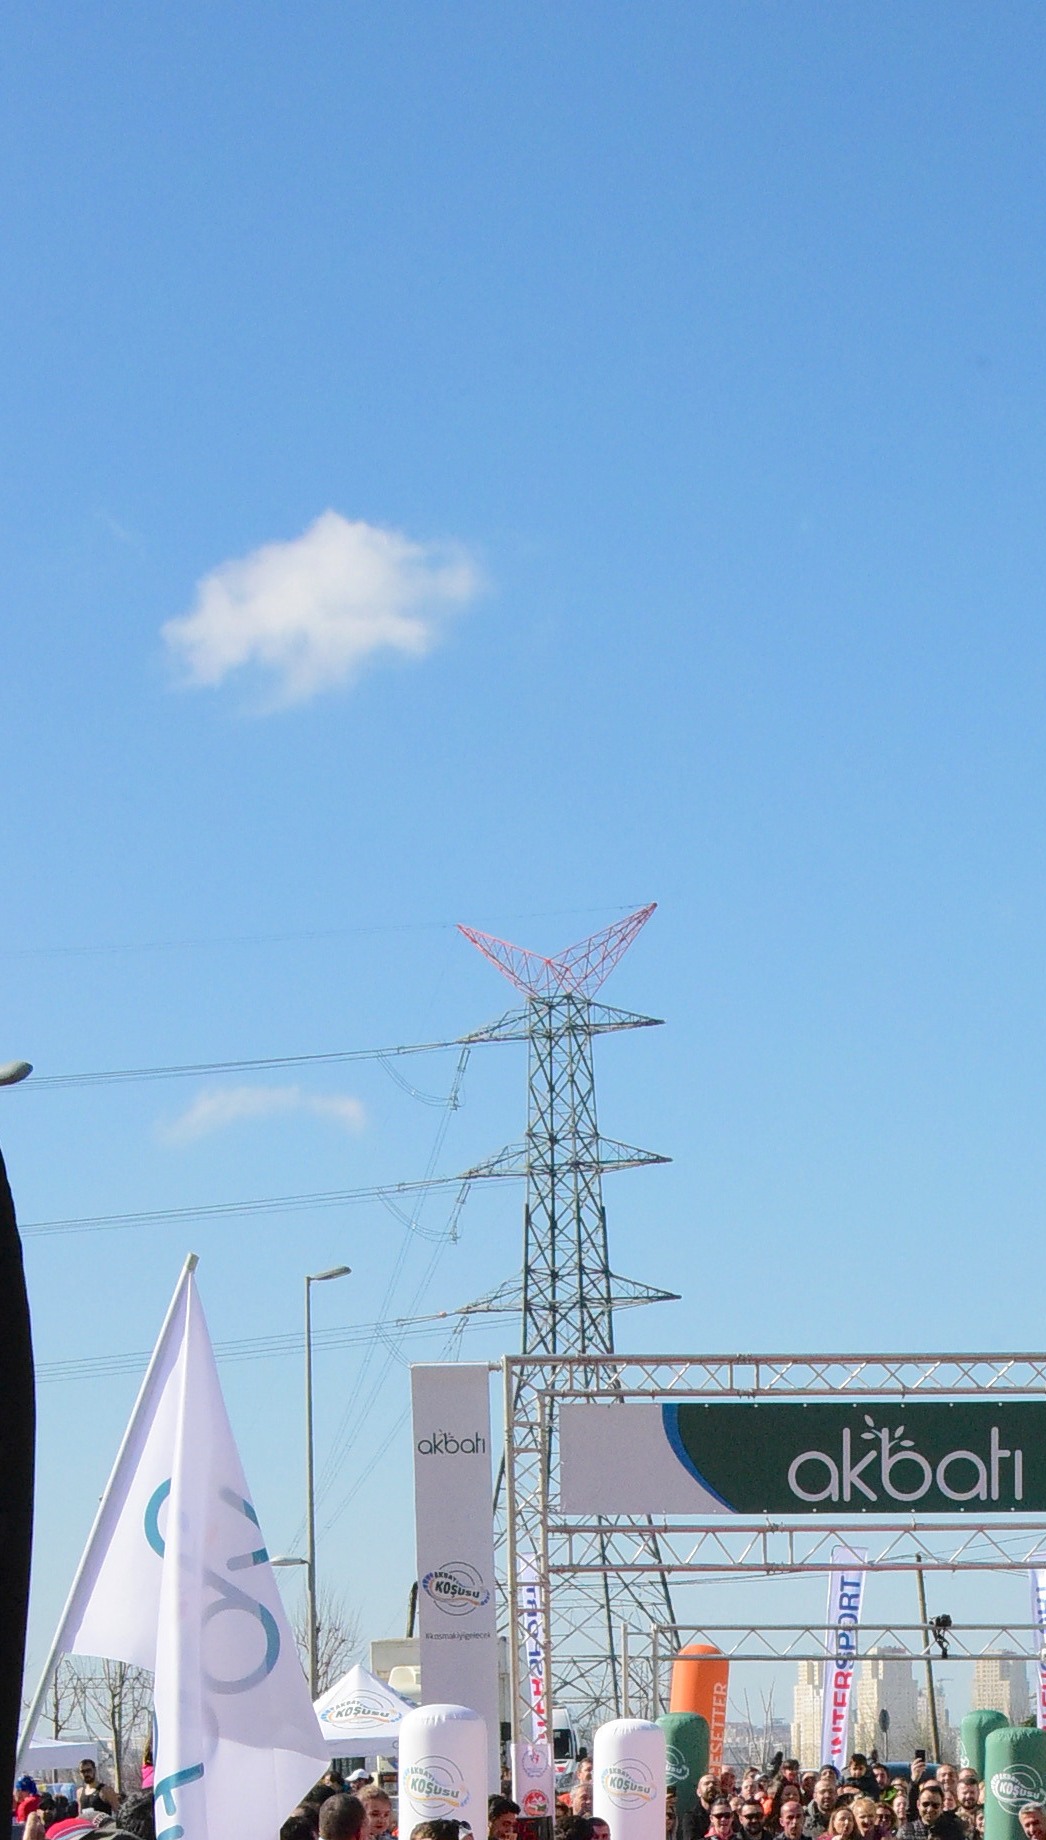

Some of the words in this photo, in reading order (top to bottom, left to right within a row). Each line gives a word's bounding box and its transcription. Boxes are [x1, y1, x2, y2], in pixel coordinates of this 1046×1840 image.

[417, 1431, 486, 1455] akbatı
[787, 1425, 1023, 1502] akbatı
[435, 1580, 480, 1598] KOŞUSU
[410, 1778, 460, 1798] KOŞUSU
[609, 1777, 651, 1793] KOŞUSU
[1000, 1781, 1040, 1799] KOŞUSU
